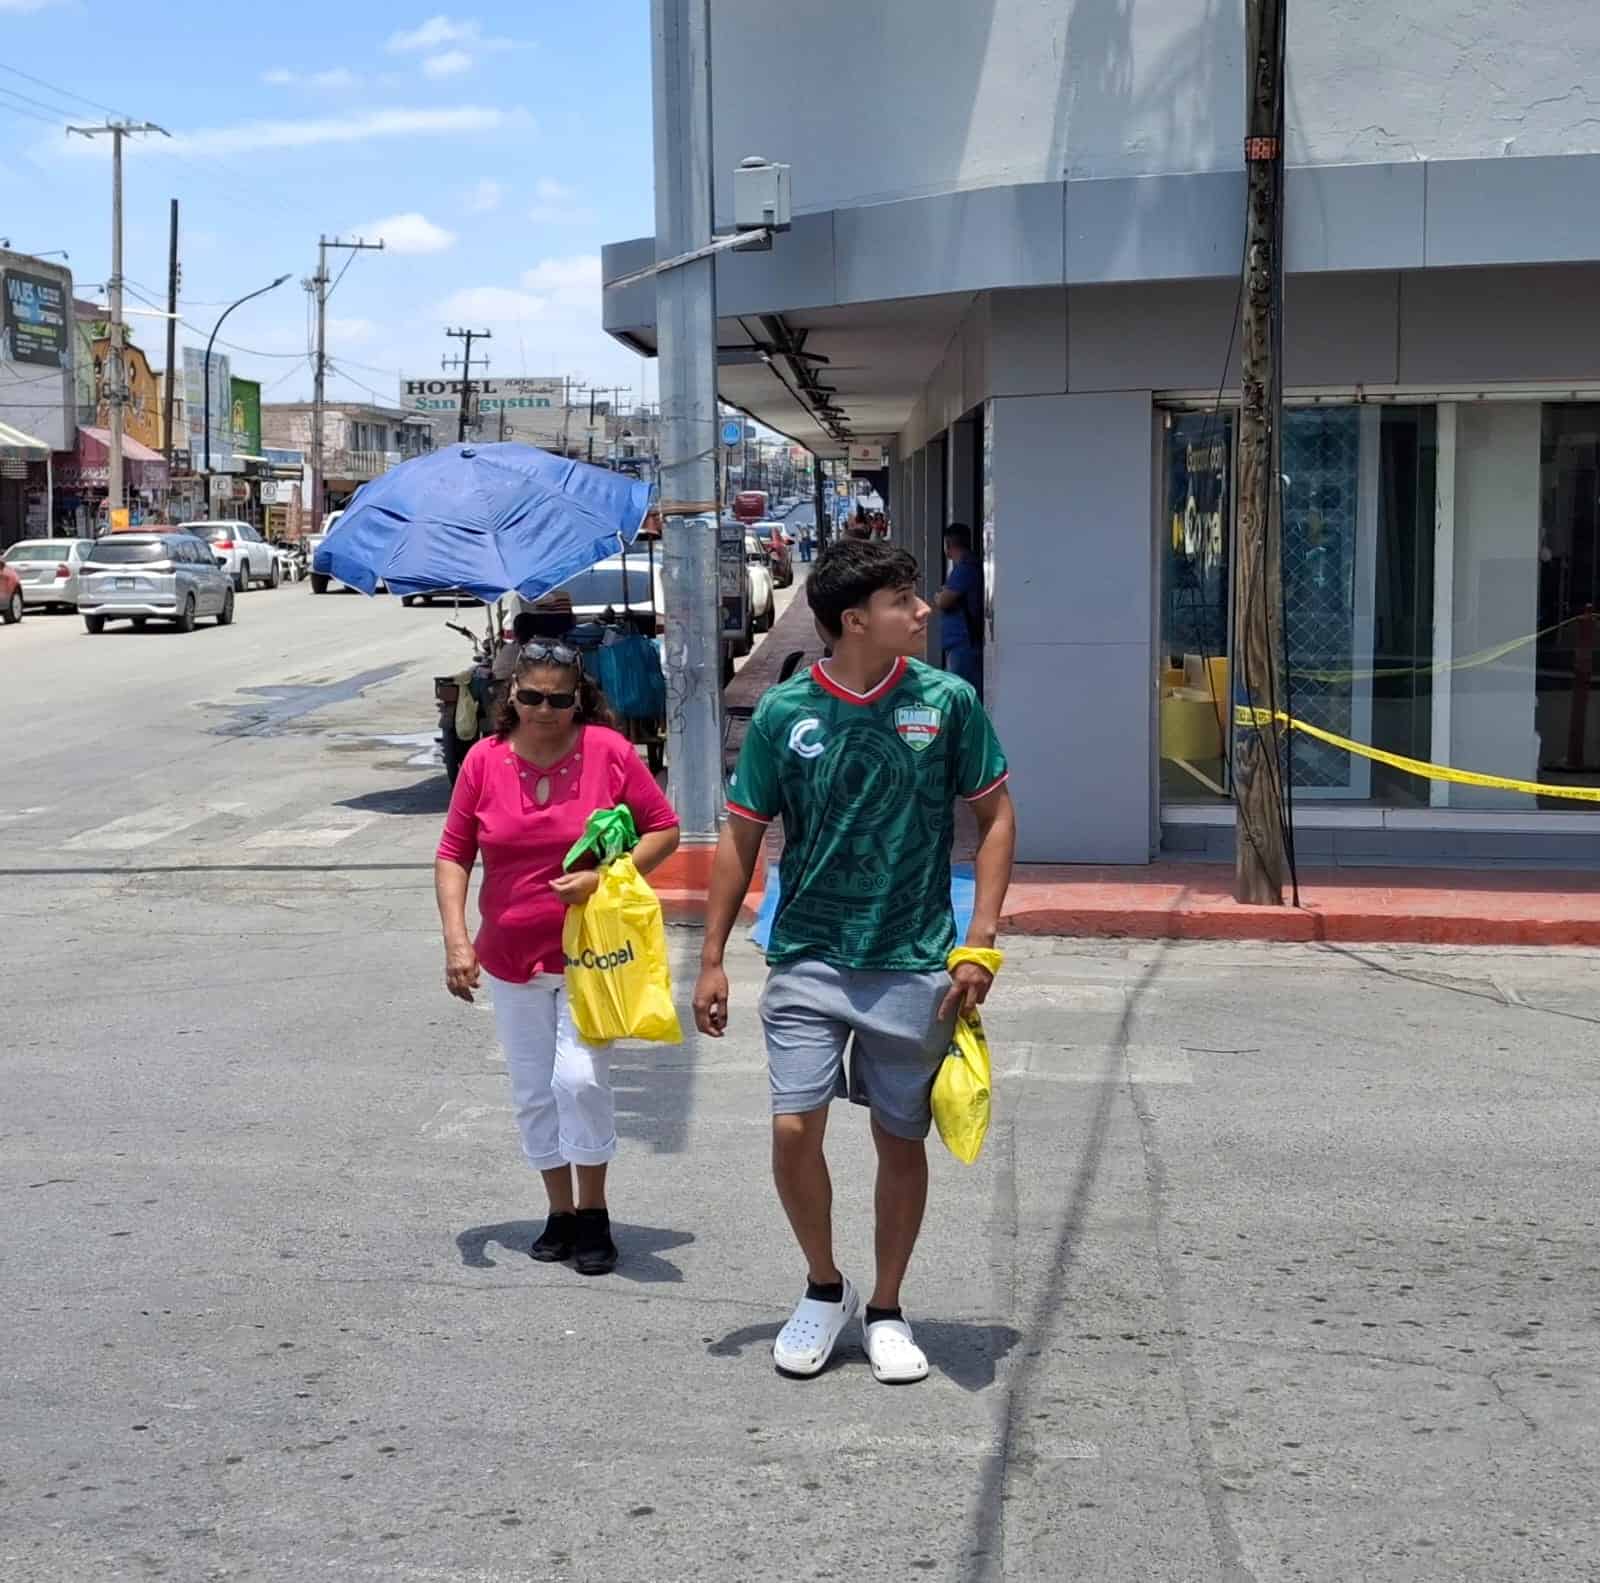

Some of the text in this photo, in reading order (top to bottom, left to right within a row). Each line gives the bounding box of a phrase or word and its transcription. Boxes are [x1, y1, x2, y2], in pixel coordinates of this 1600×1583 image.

[407, 380, 497, 394] HOTEL
[415, 395, 551, 411] San gustin
